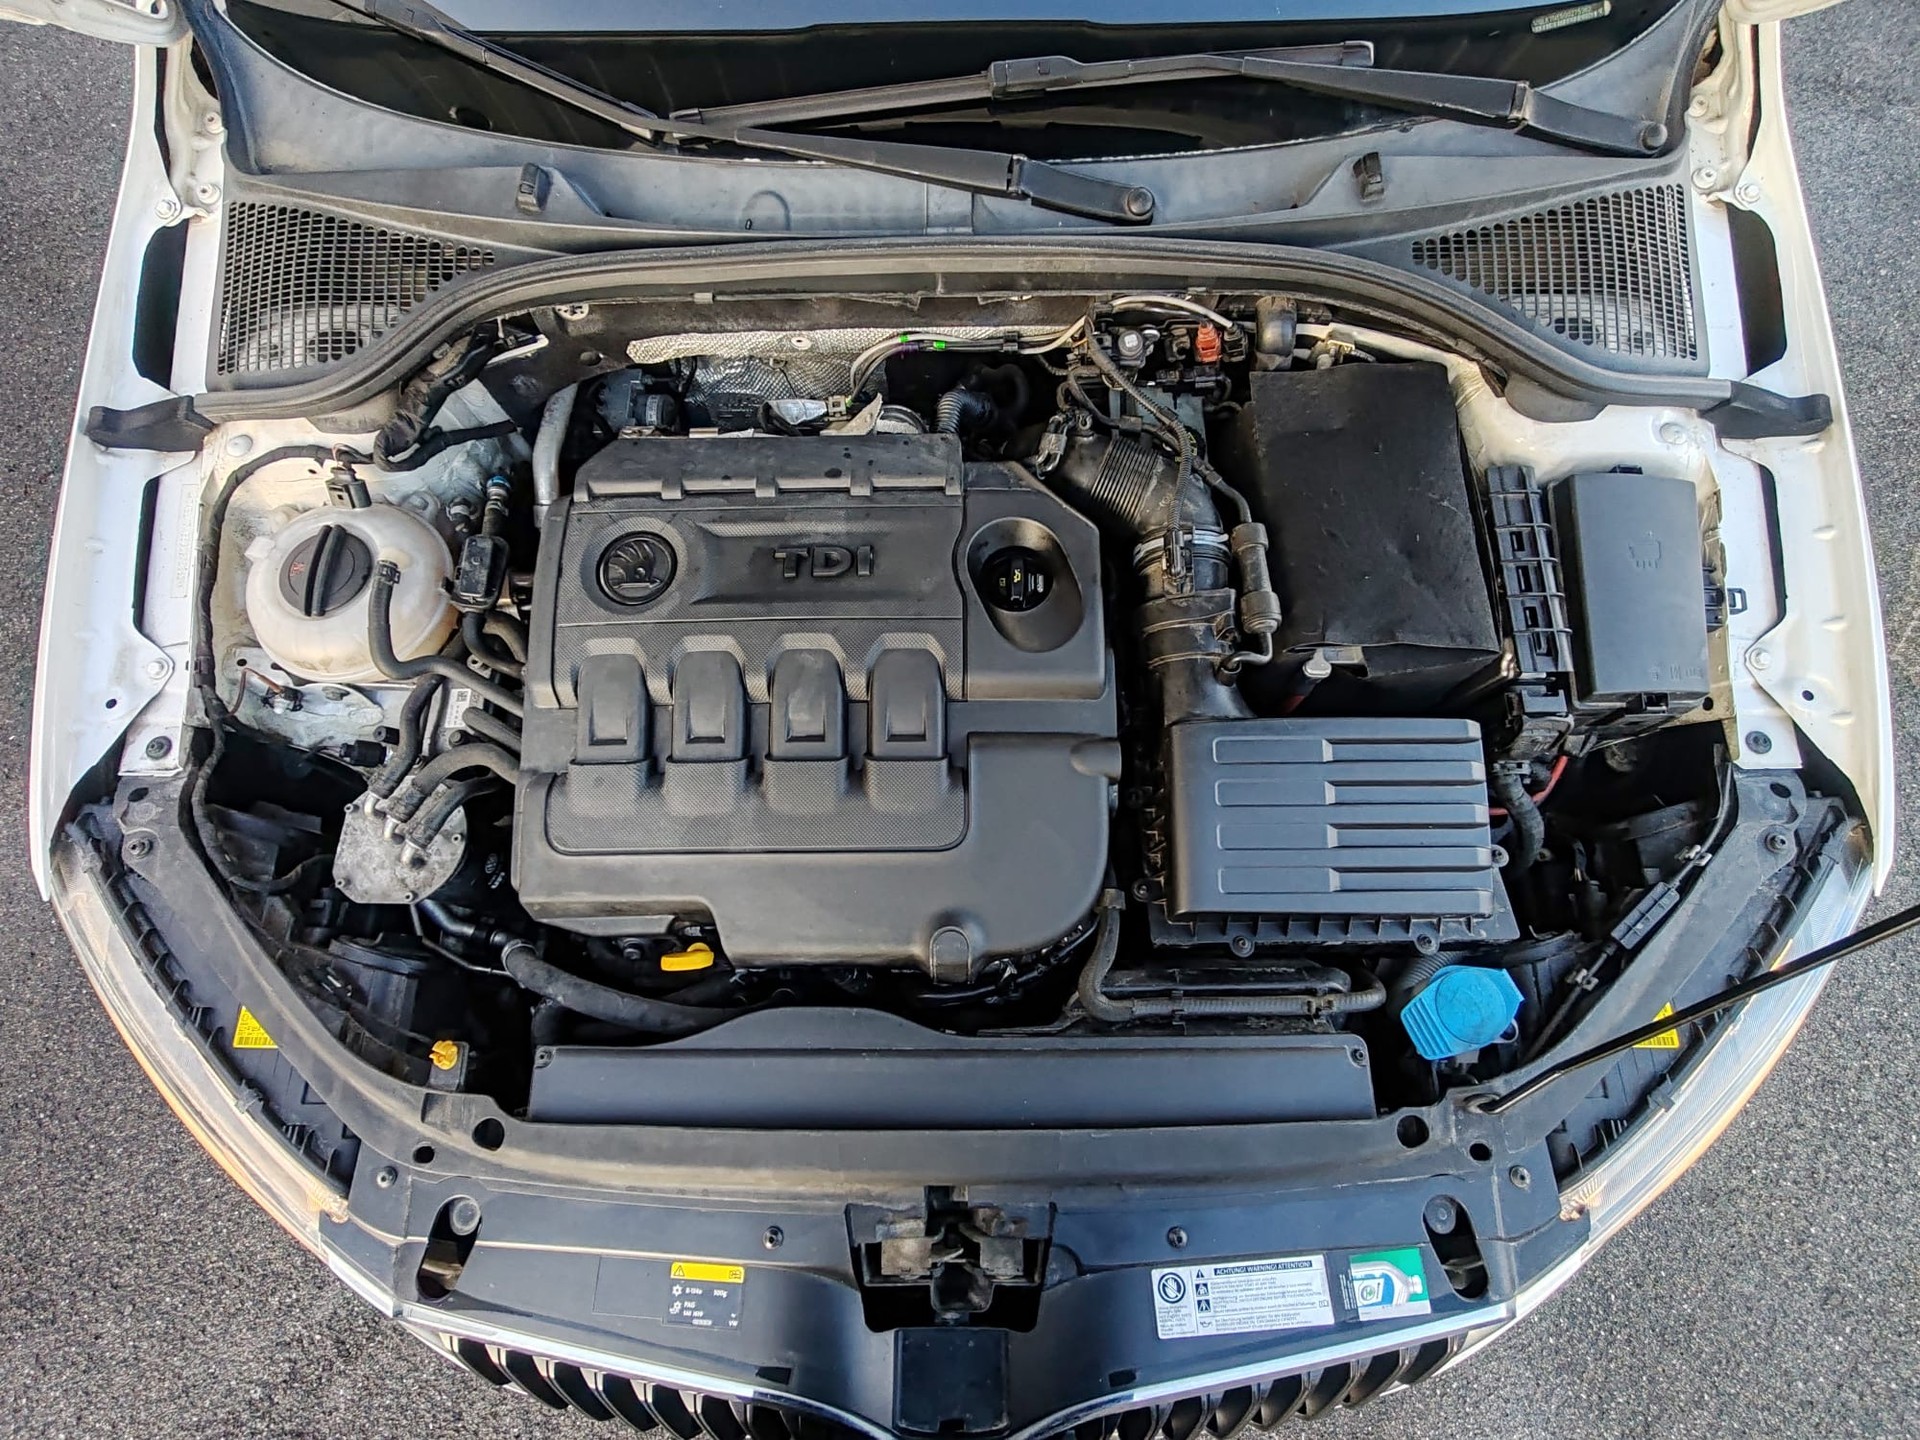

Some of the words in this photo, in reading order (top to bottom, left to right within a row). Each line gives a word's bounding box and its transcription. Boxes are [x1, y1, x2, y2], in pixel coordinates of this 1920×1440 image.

[773, 545, 874, 578] TDI
[1216, 1267, 1246, 1275] ACHTUNG!
[1246, 1264, 1277, 1273] WARNING!
[1277, 1261, 1310, 1270] ATTENTION!
